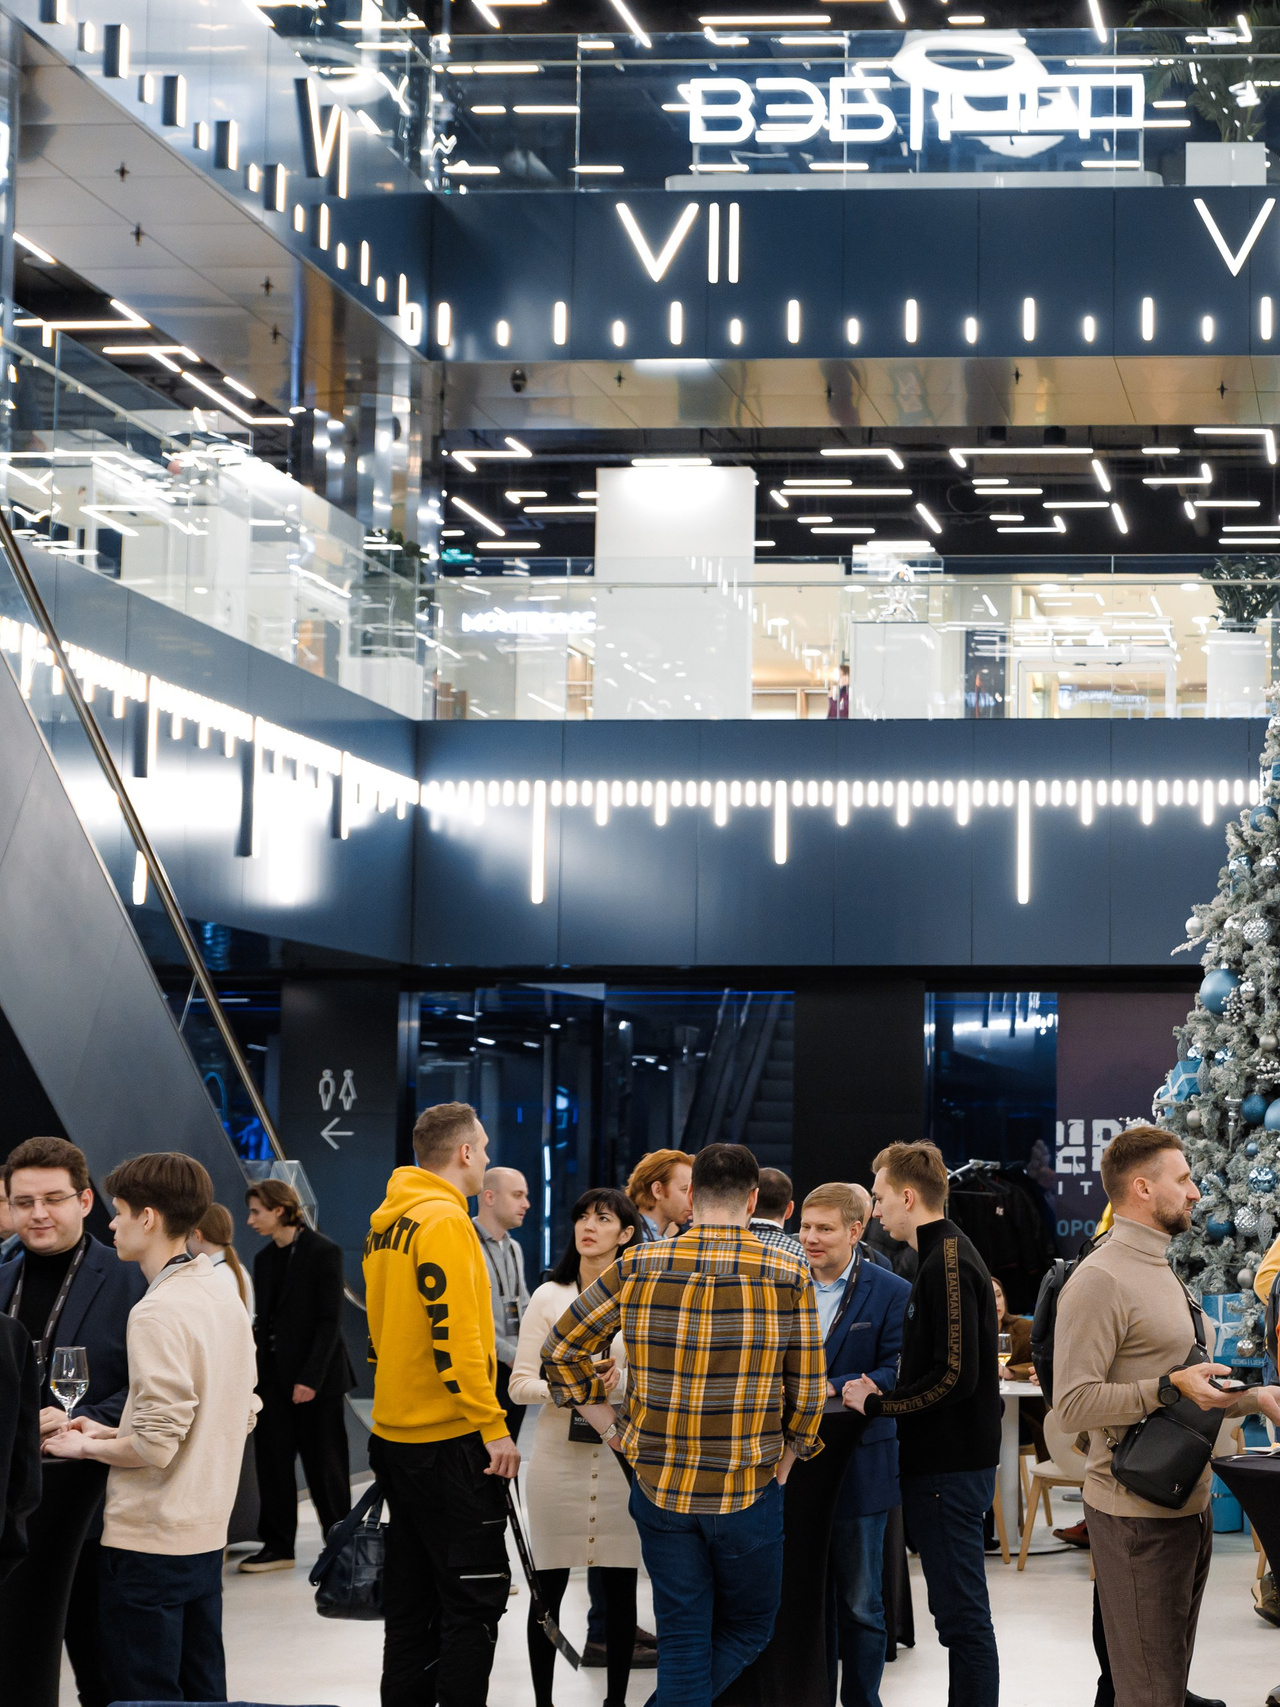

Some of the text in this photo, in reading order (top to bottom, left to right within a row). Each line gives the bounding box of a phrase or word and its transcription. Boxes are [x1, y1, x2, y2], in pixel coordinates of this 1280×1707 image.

[615, 202, 740, 284] VII
[948, 1272, 960, 1320] BALMAIN
[950, 1323, 961, 1371] BALMAIN
